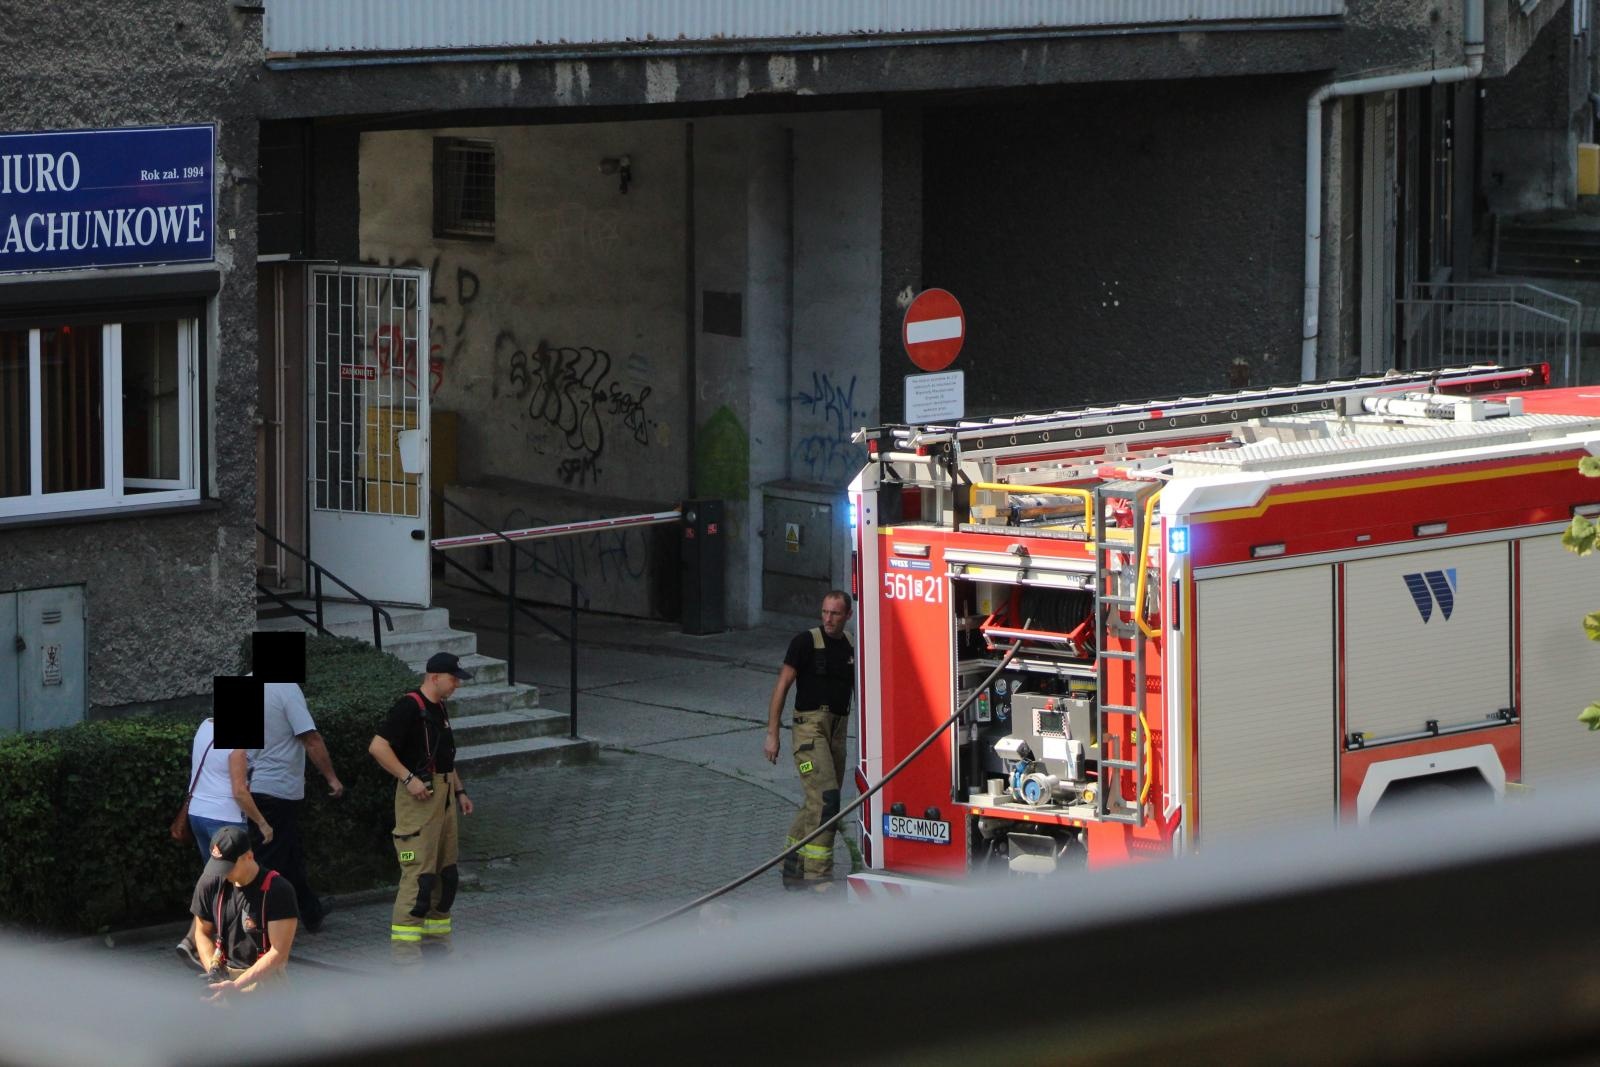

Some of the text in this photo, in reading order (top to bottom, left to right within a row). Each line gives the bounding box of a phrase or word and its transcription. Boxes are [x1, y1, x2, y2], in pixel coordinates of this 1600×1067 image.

[0, 151, 80, 193] IURO
[141, 166, 204, 181] Rok zał. 1994
[0, 204, 204, 254] ACHUNKOWE
[891, 817, 913, 834] SRC
